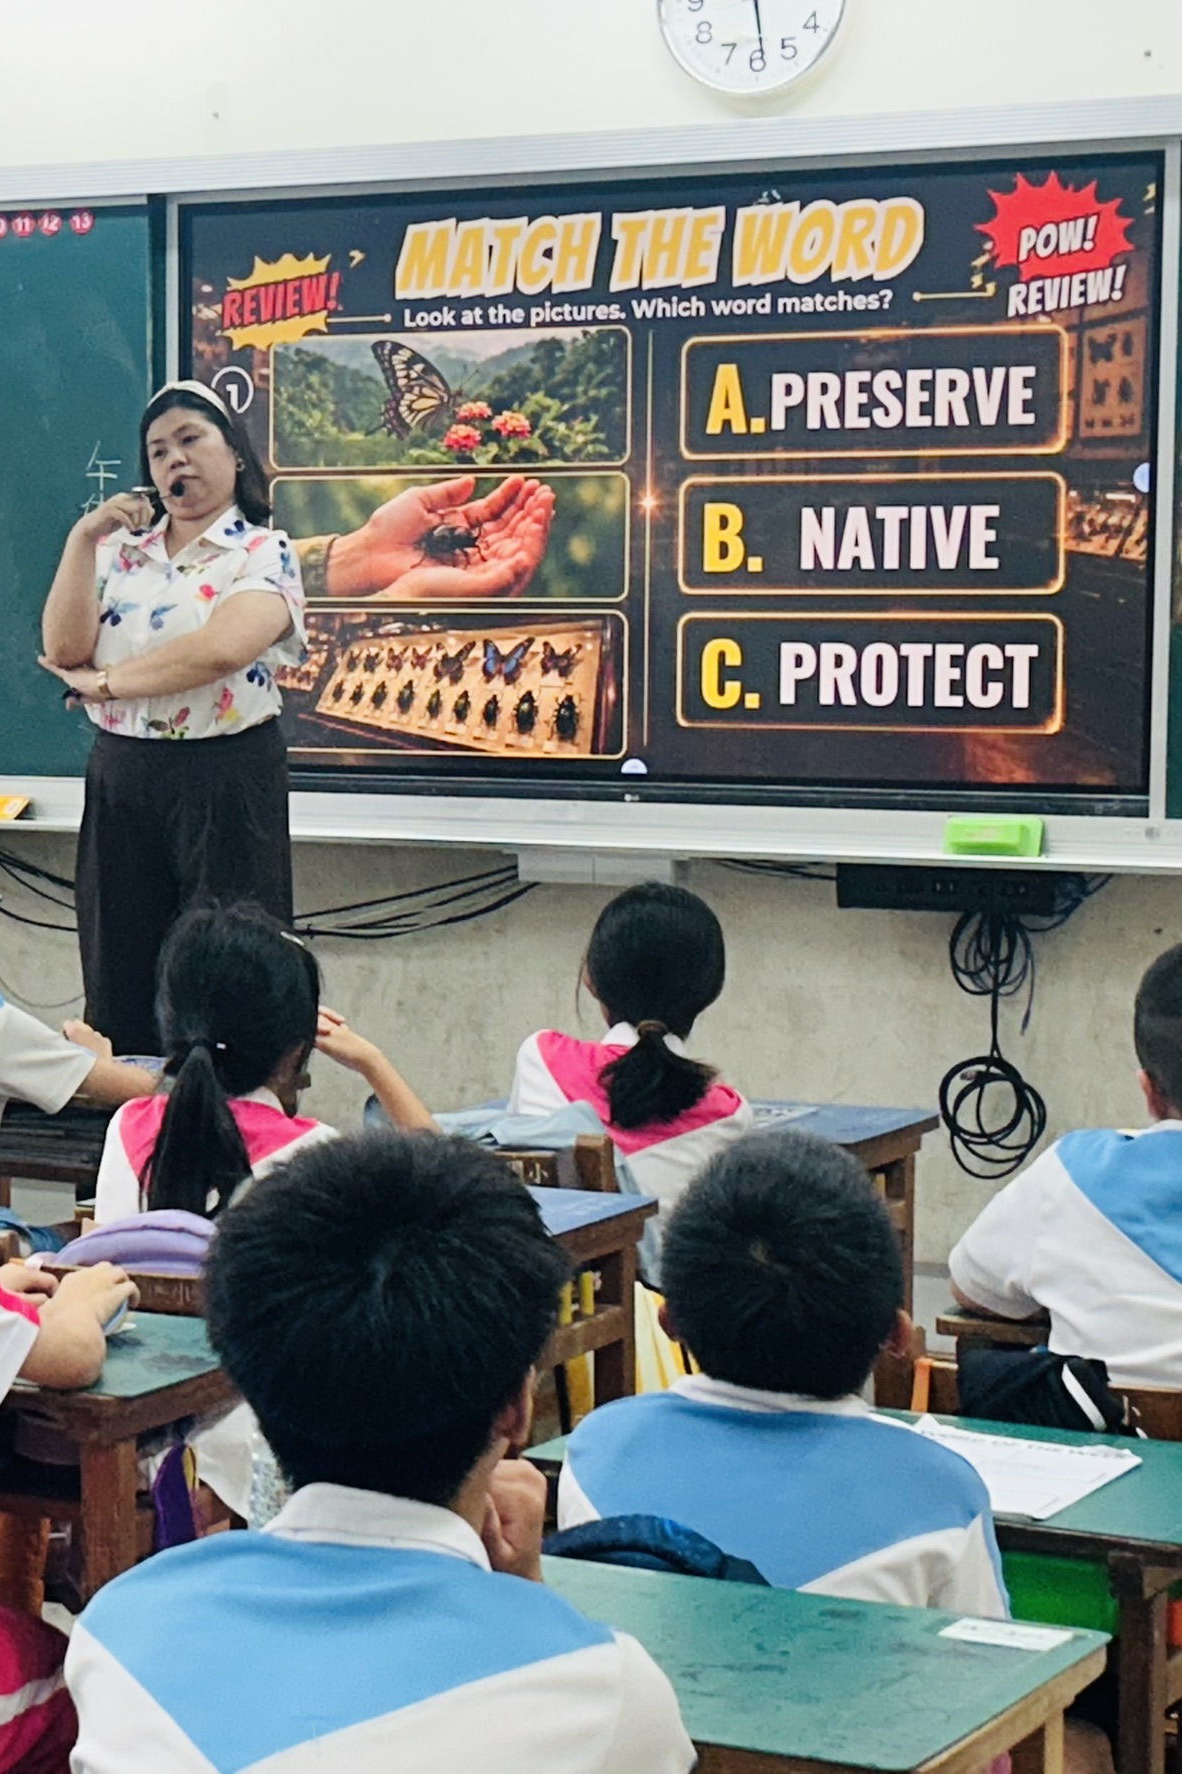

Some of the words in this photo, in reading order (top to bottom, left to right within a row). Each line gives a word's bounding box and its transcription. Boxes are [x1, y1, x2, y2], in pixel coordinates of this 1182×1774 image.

[695, 21, 713, 44] 8
[802, 10, 819, 33] 4
[721, 43, 737, 65] 7
[749, 49, 766, 72] 6
[780, 37, 798, 60] 5
[17, 216, 32, 232] 11
[42, 213, 59, 231] 12
[72, 212, 91, 229] 13
[1018, 214, 1099, 262] POW!
[395, 216, 602, 300] MATCH
[609, 206, 726, 293] THE
[732, 197, 925, 287] WORD
[222, 271, 343, 329] REVIEW!
[403, 306, 456, 328] Look
[461, 308, 483, 325] at
[488, 304, 525, 324] the
[530, 301, 626, 327] pictures.
[631, 296, 706, 319] Which
[711, 292, 772, 316] word
[777, 289, 894, 314] matches?
[1007, 264, 1127, 318] REVIEW!
[705, 362, 766, 435] A.
[771, 366, 1036, 431] PRESERVE
[703, 501, 764, 573] B.
[800, 505, 1001, 570] NATIVE
[701, 638, 761, 710] C.
[779, 641, 1040, 709] PROTECT
